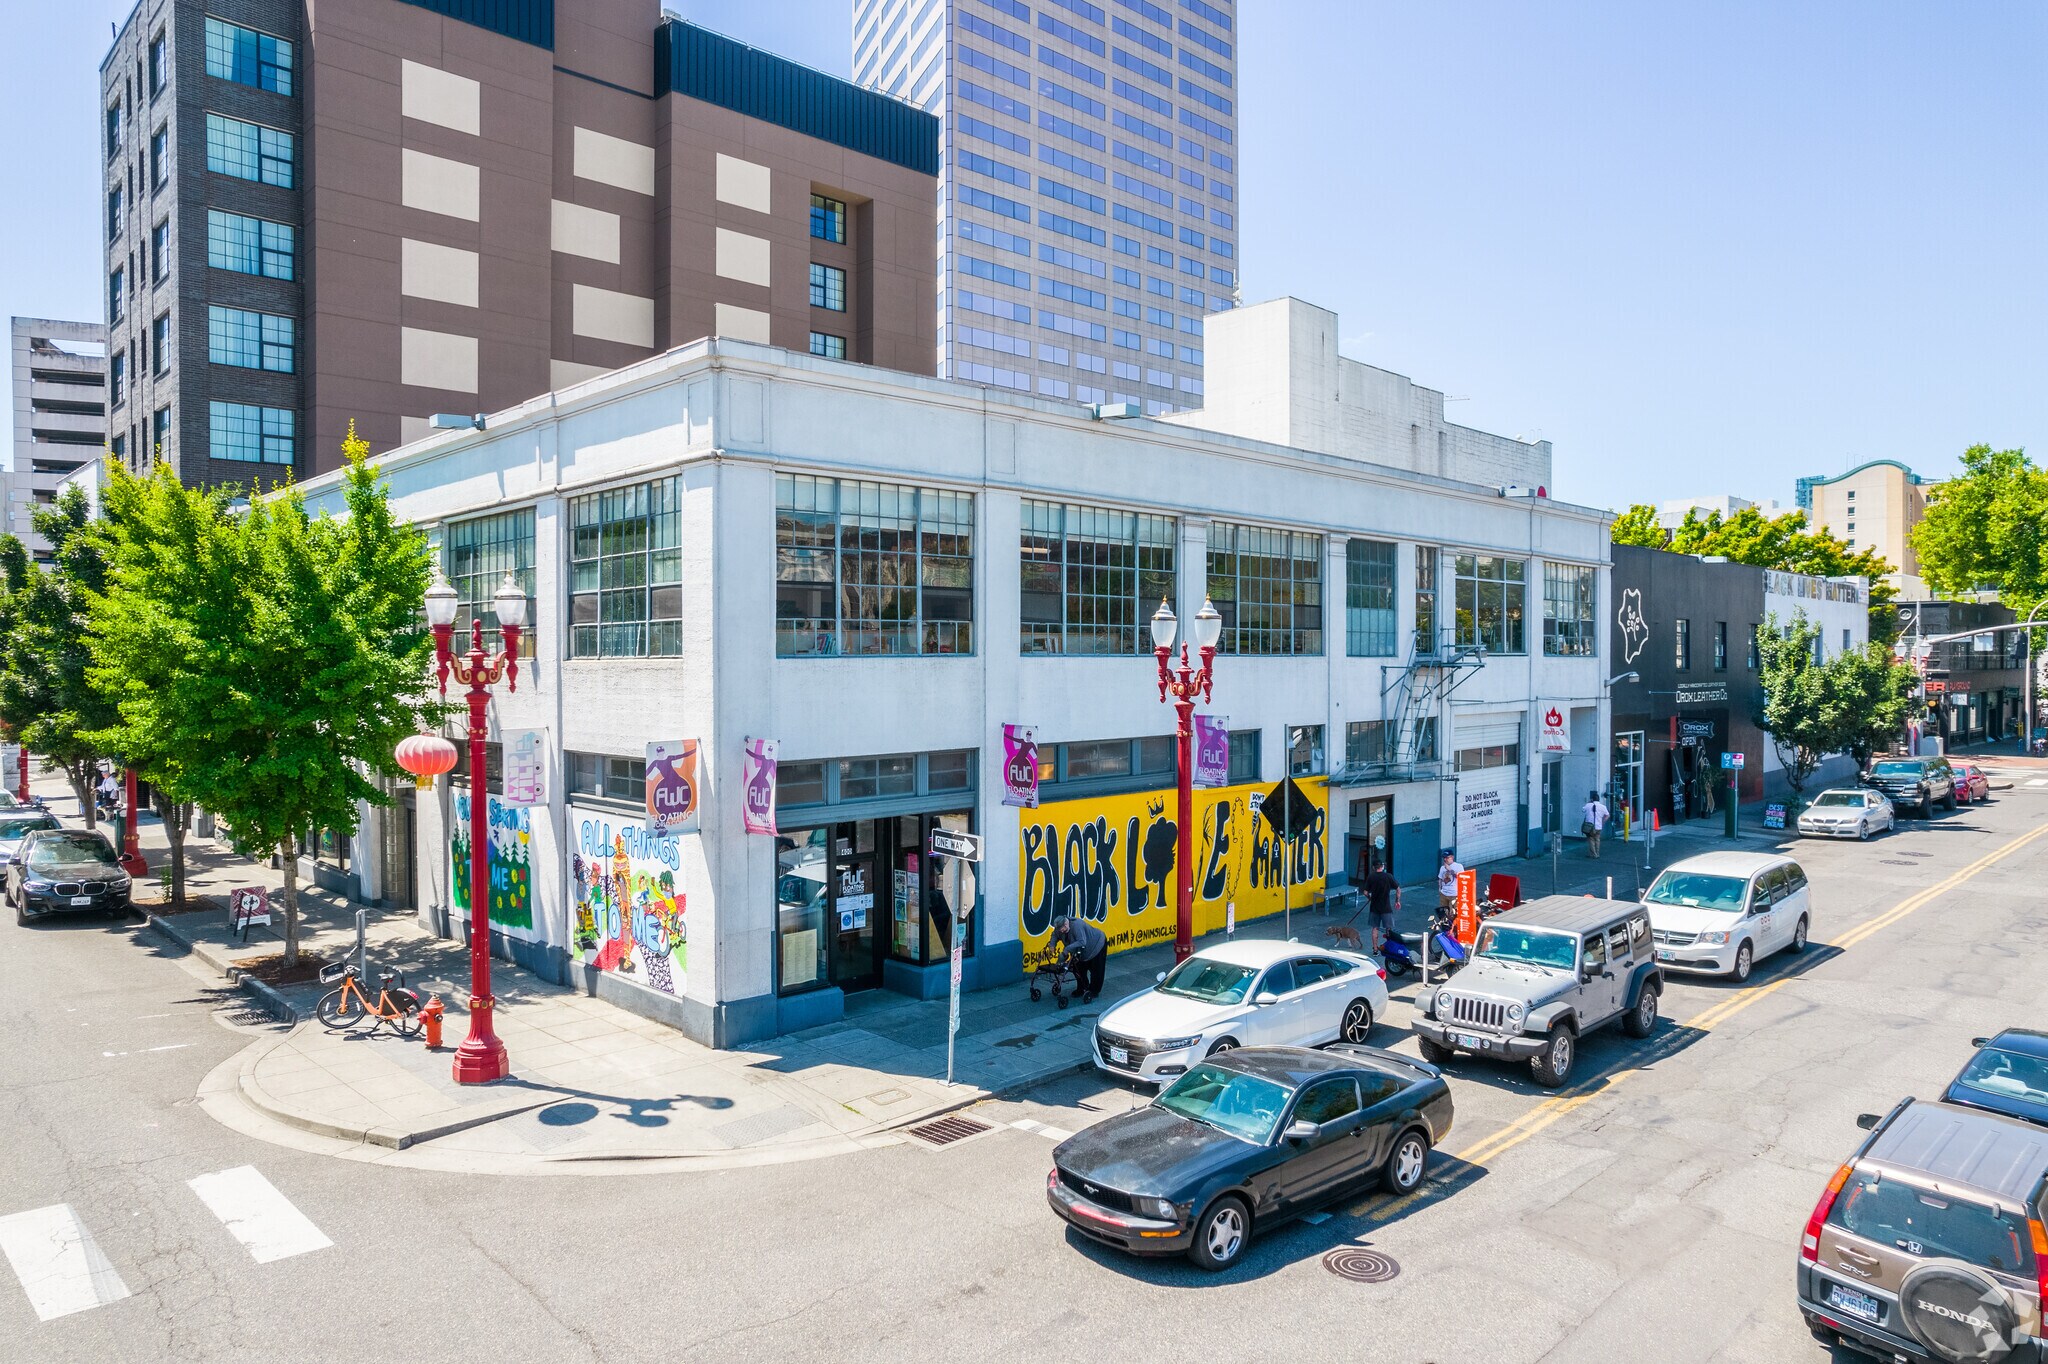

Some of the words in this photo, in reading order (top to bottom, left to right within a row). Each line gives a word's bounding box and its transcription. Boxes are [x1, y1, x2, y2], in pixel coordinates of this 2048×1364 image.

[1798, 577, 1822, 600] LIVES
[1826, 582, 1856, 603] MATTER
[1676, 690, 1693, 703] OROX
[1694, 690, 1720, 702] LEATHER
[1682, 736, 1696, 746] OPEN
[1203, 749, 1223, 765] FWC
[1010, 765, 1032, 783] FWC
[655, 785, 690, 808] FWC
[749, 787, 770, 808] FWC
[1473, 793, 1482, 801] NOT
[1483, 791, 1498, 800] BLOCK
[1462, 802, 1483, 811] SUBJECT
[1471, 811, 1476, 819] 24
[1477, 809, 1493, 817] HOURS
[581, 820, 616, 858] ALL
[622, 825, 680, 871] THINGS
[936, 836, 949, 848] ONE
[950, 840, 964, 851] WAY
[491, 863, 508, 891] ME
[842, 869, 865, 886] FWC
[1021, 814, 1120, 937] BLACK
[594, 902, 621, 940] TO
[632, 904, 661, 952] ME
[1116, 930, 1129, 945] FAM
[1918, 1299, 1998, 1333] HONDA
